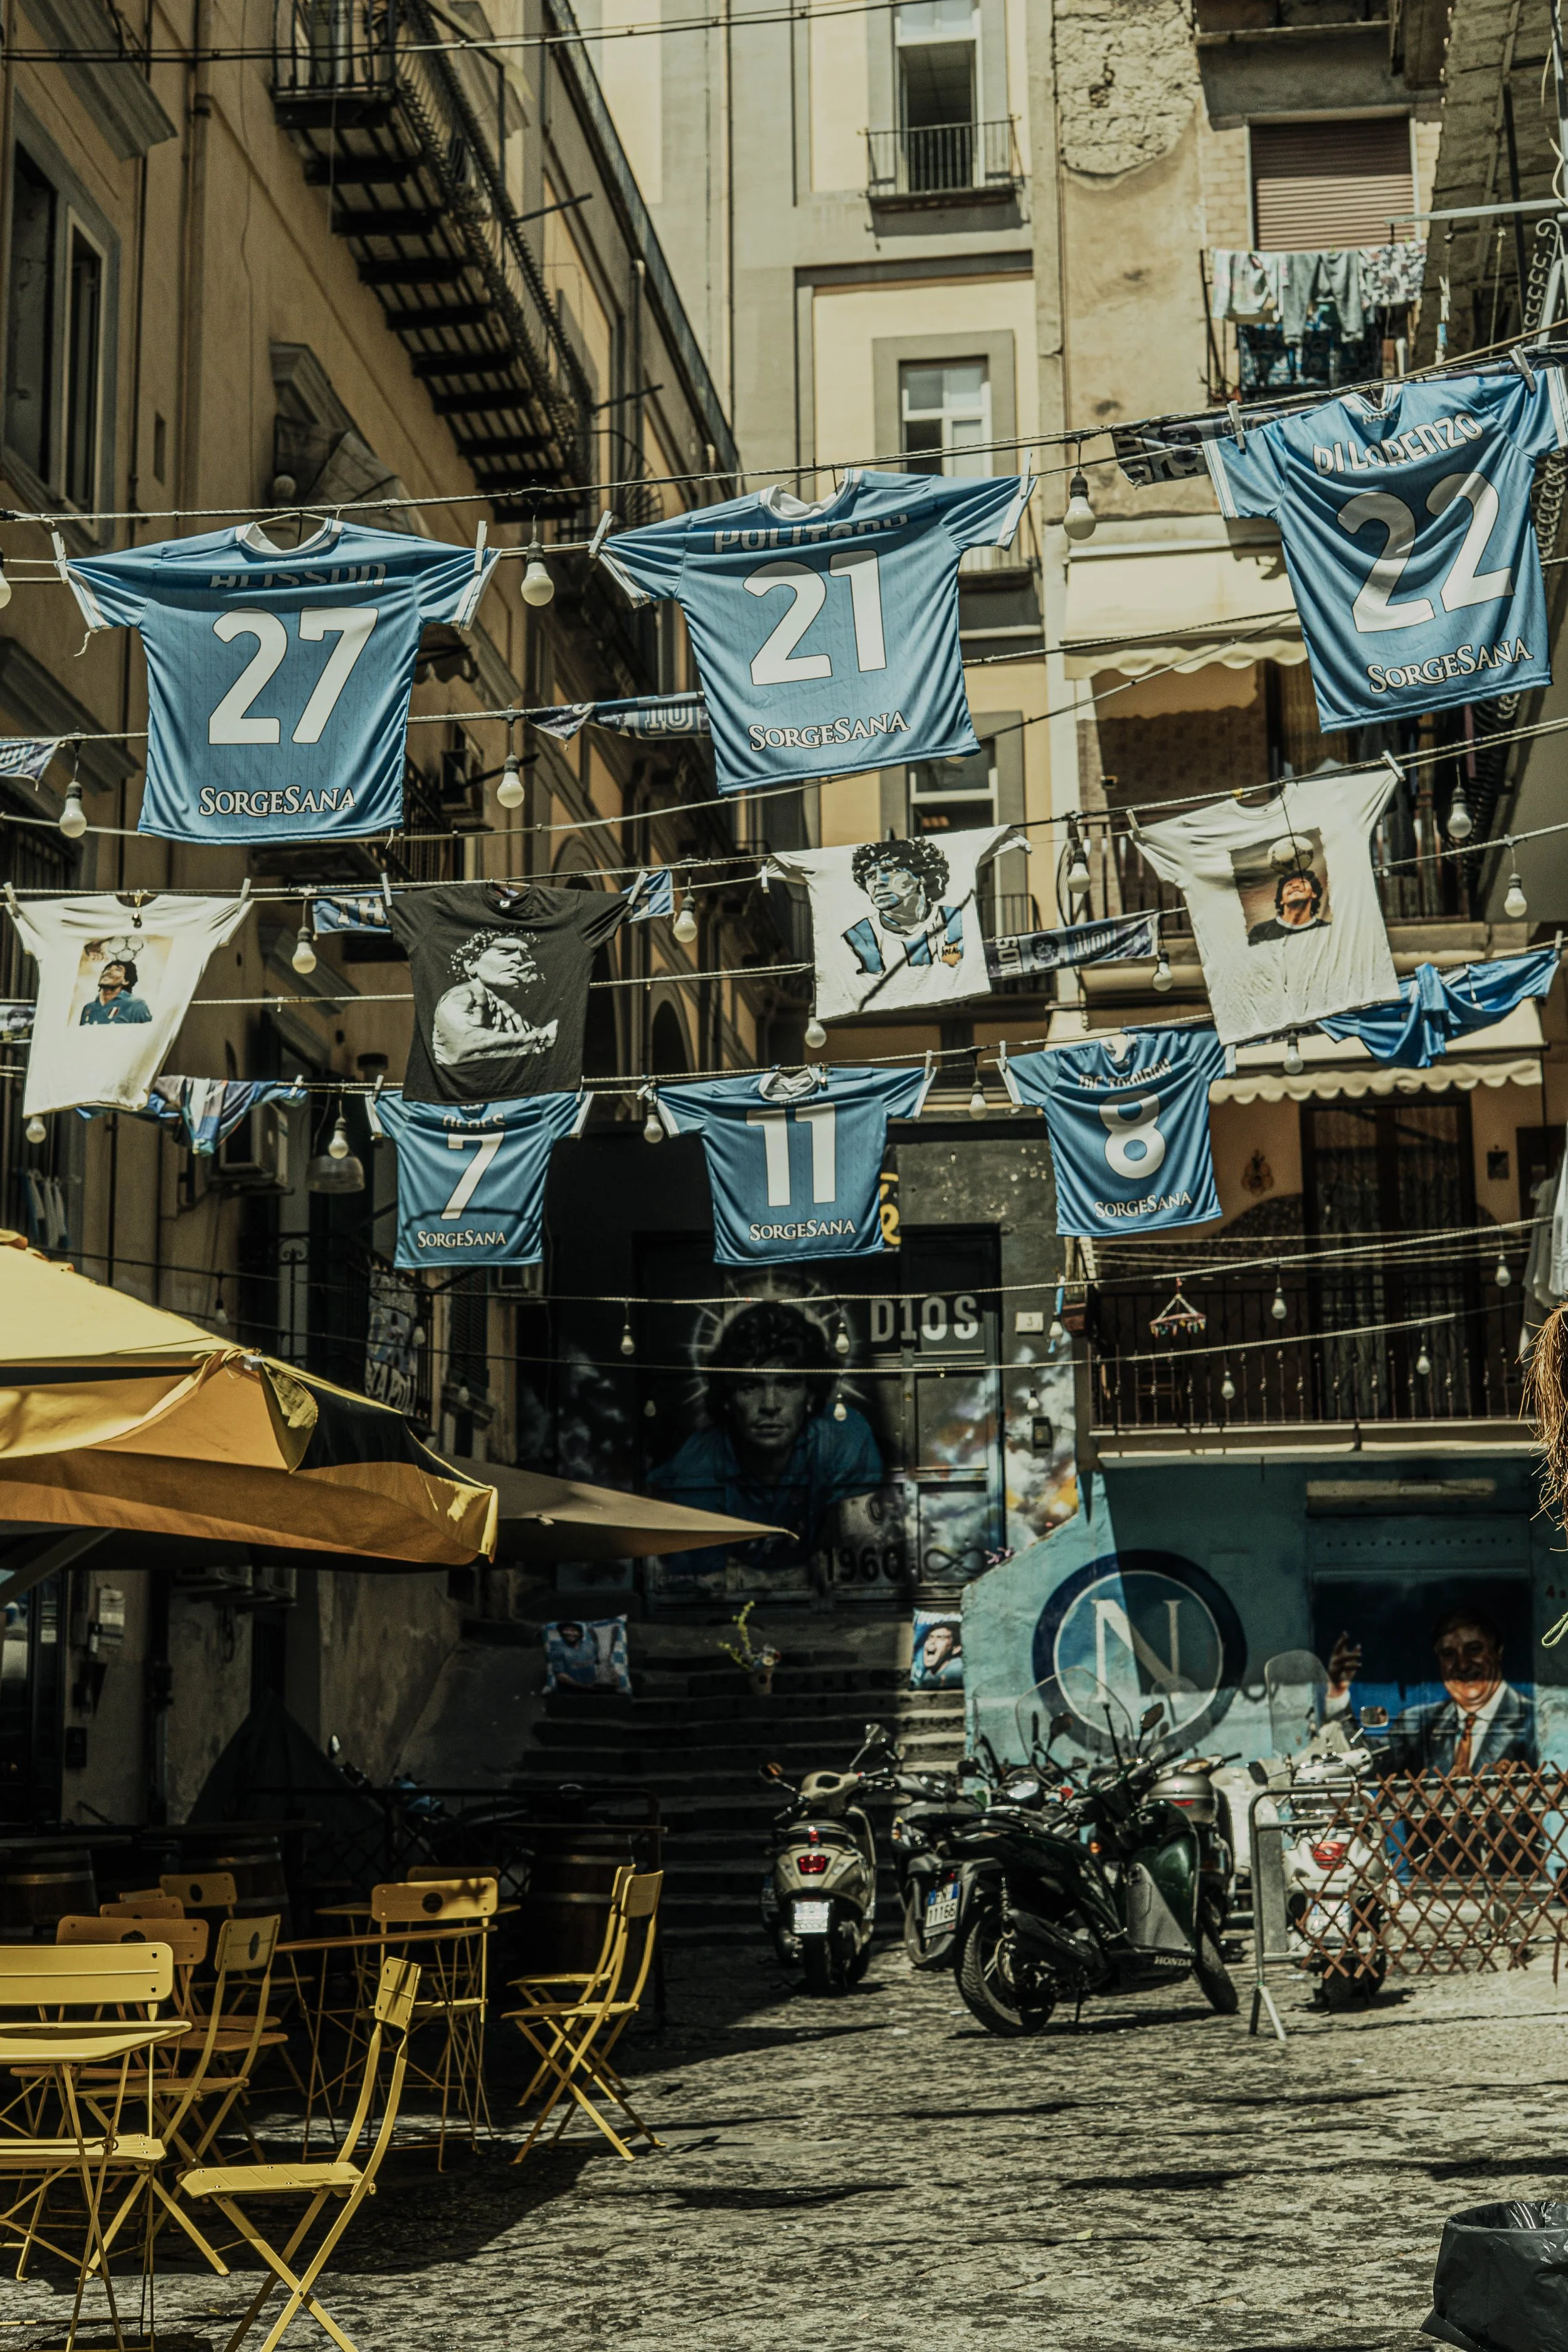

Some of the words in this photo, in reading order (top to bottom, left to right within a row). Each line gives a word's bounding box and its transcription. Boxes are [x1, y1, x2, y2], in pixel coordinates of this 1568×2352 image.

[1313, 441, 1345, 476] DI
[1348, 412, 1483, 472] LORENZO
[1362, 411, 1401, 425] NAPOL
[209, 563, 387, 588] ALISSON
[714, 513, 909, 553] POLITANO
[1337, 472, 1516, 633] 22
[743, 549, 887, 686] 21
[208, 607, 379, 745] 27
[440, 1131, 506, 1221] 7
[745, 1101, 837, 1207] 11
[1098, 1089, 1166, 1180] 8
[822, 1546, 902, 1581] 1960
[1089, 1599, 1187, 1703] N
[1153, 1955, 1192, 1967] HONDA
